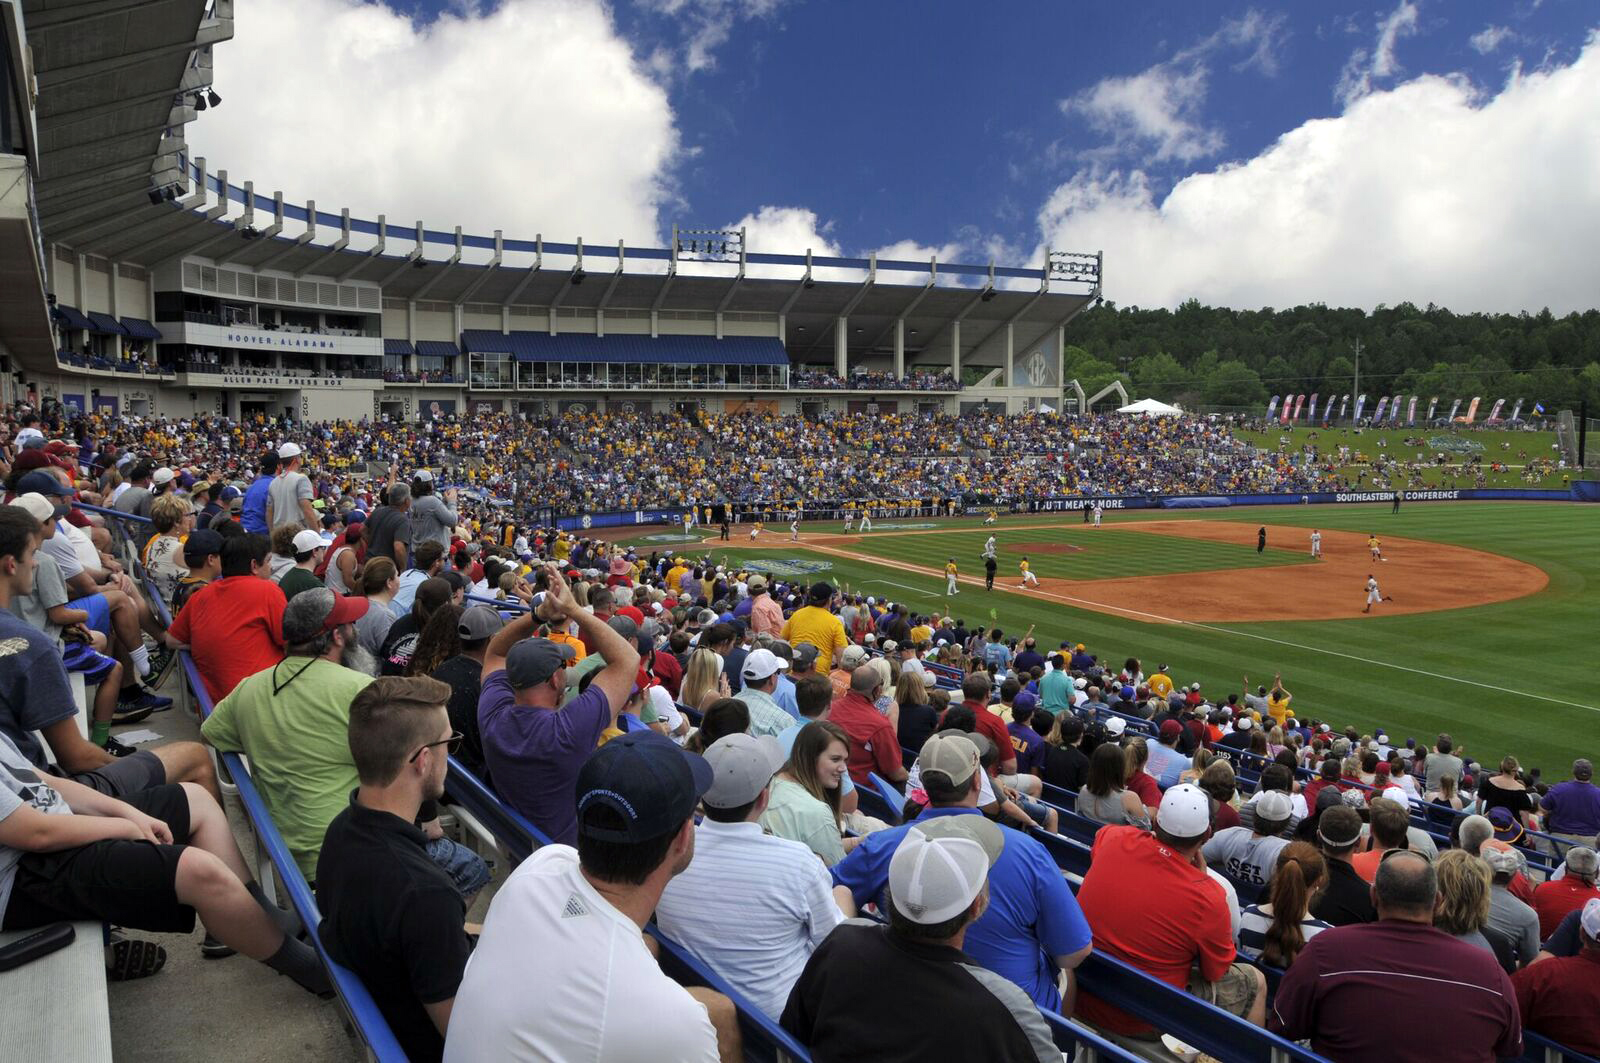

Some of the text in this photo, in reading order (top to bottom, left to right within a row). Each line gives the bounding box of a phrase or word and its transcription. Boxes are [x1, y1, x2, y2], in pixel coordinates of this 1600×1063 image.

[281, 338, 334, 348] ALABAMA
[224, 376, 251, 384] ALLEN
[289, 378, 317, 386] PRESS
[1336, 490, 1459, 502] SOUTHEASTERN CONFERENCE
[1098, 499, 1126, 510] MORE.
[966, 506, 1009, 514] SECSPORTS.COM
[1008, 735, 1028, 752] SU
